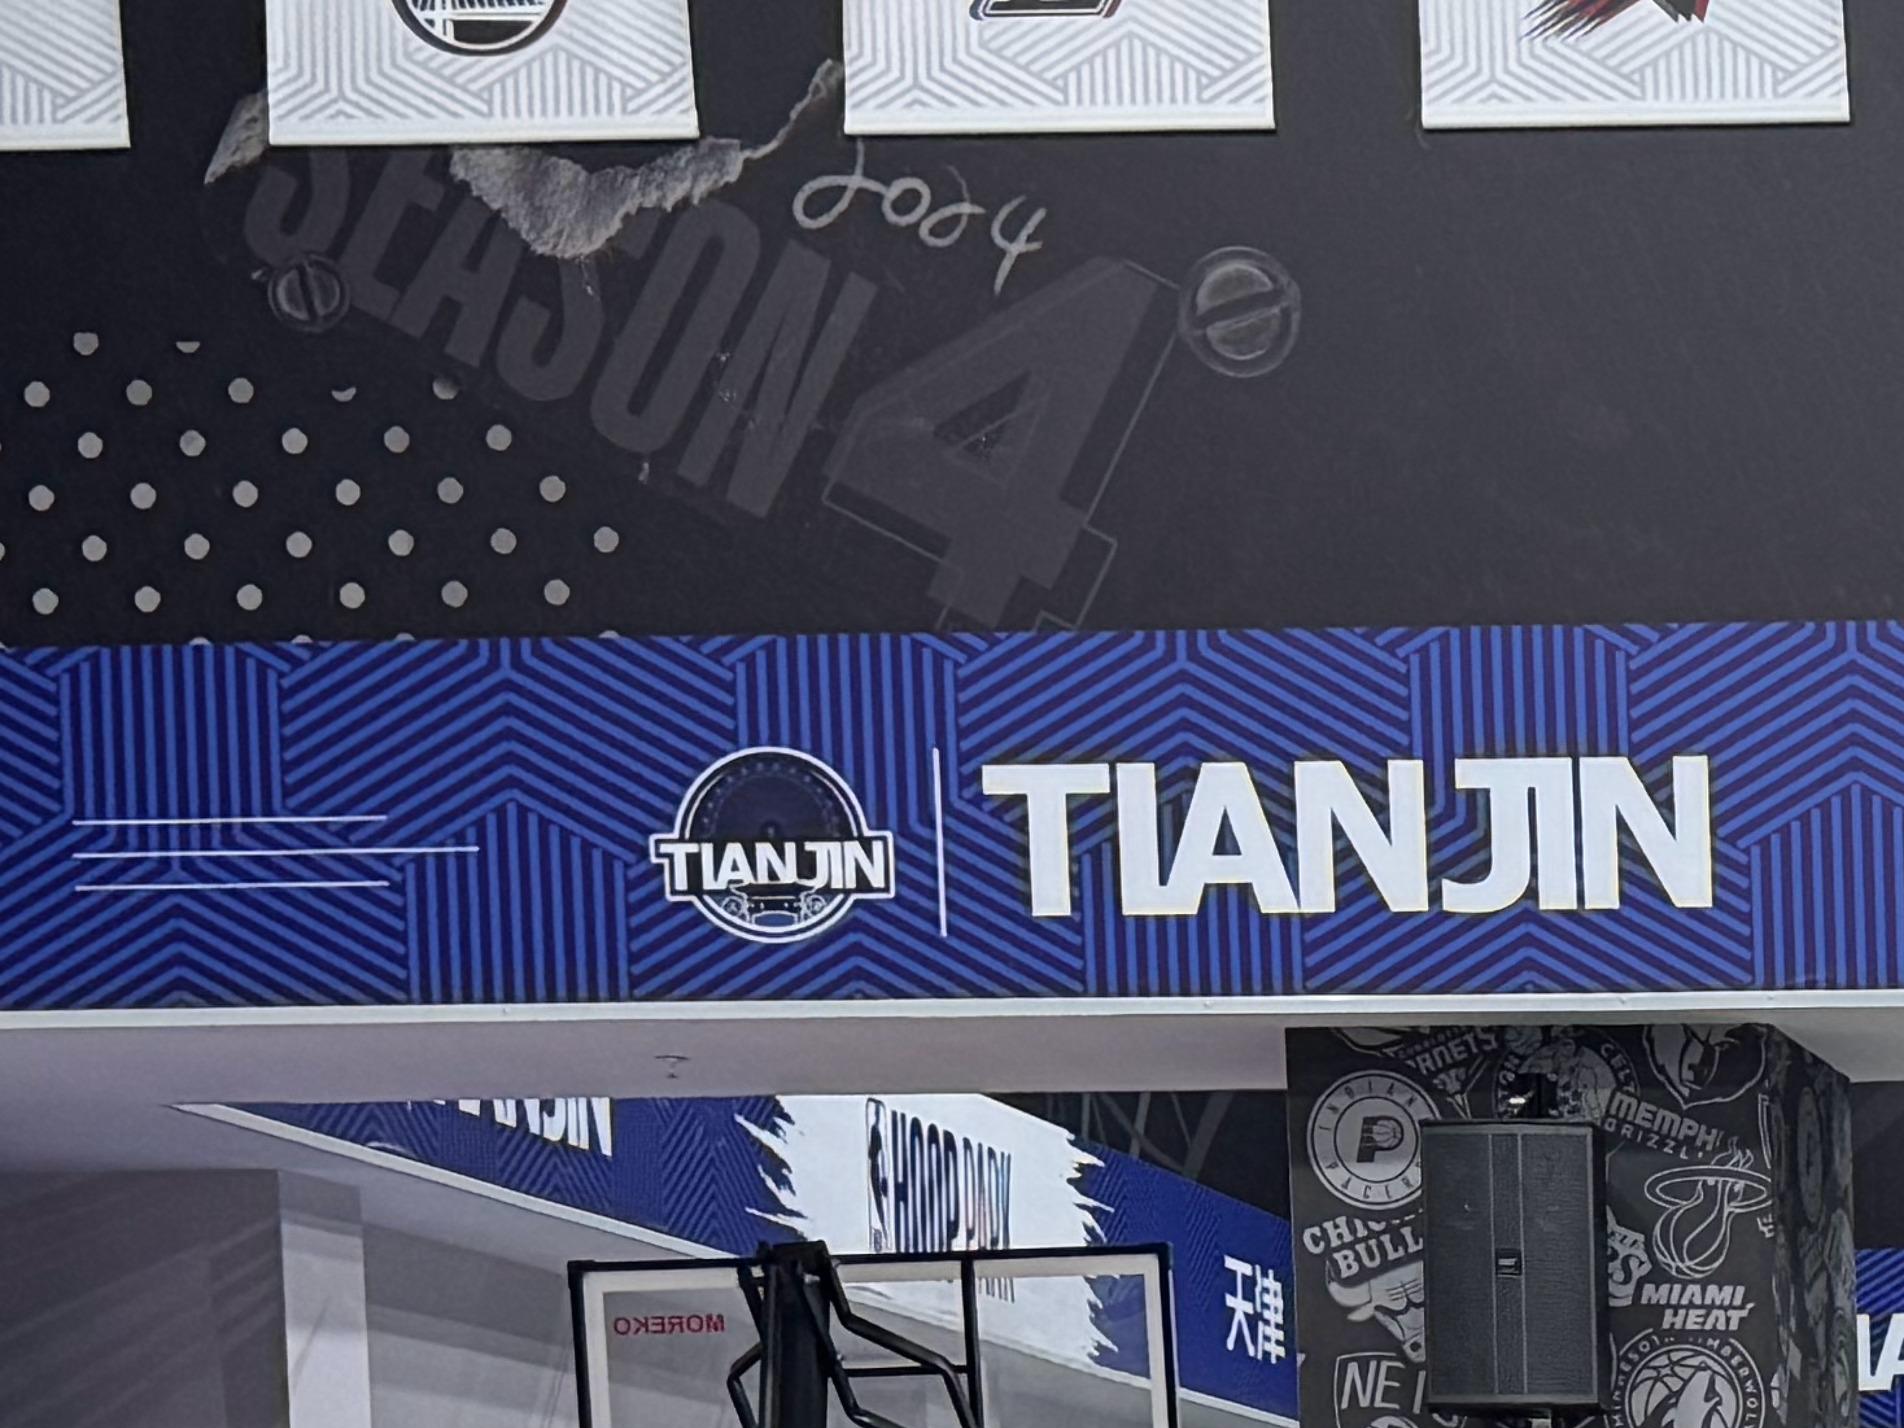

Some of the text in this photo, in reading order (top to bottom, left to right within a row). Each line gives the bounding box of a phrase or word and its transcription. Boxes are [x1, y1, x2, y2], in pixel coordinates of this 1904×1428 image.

[243, 148, 877, 519] SEASON
[982, 755, 1712, 916] TIANJIN
[658, 838, 886, 891] TIANJIN
[1404, 1022, 1498, 1077] RNETS
[1609, 1091, 1726, 1151] MEMPHI
[1333, 1227, 1424, 1280] BULL
[1223, 1255, 1286, 1364] 天津
[1641, 1284, 1748, 1306] MIAMI
[1663, 1302, 1756, 1331] HEAT
